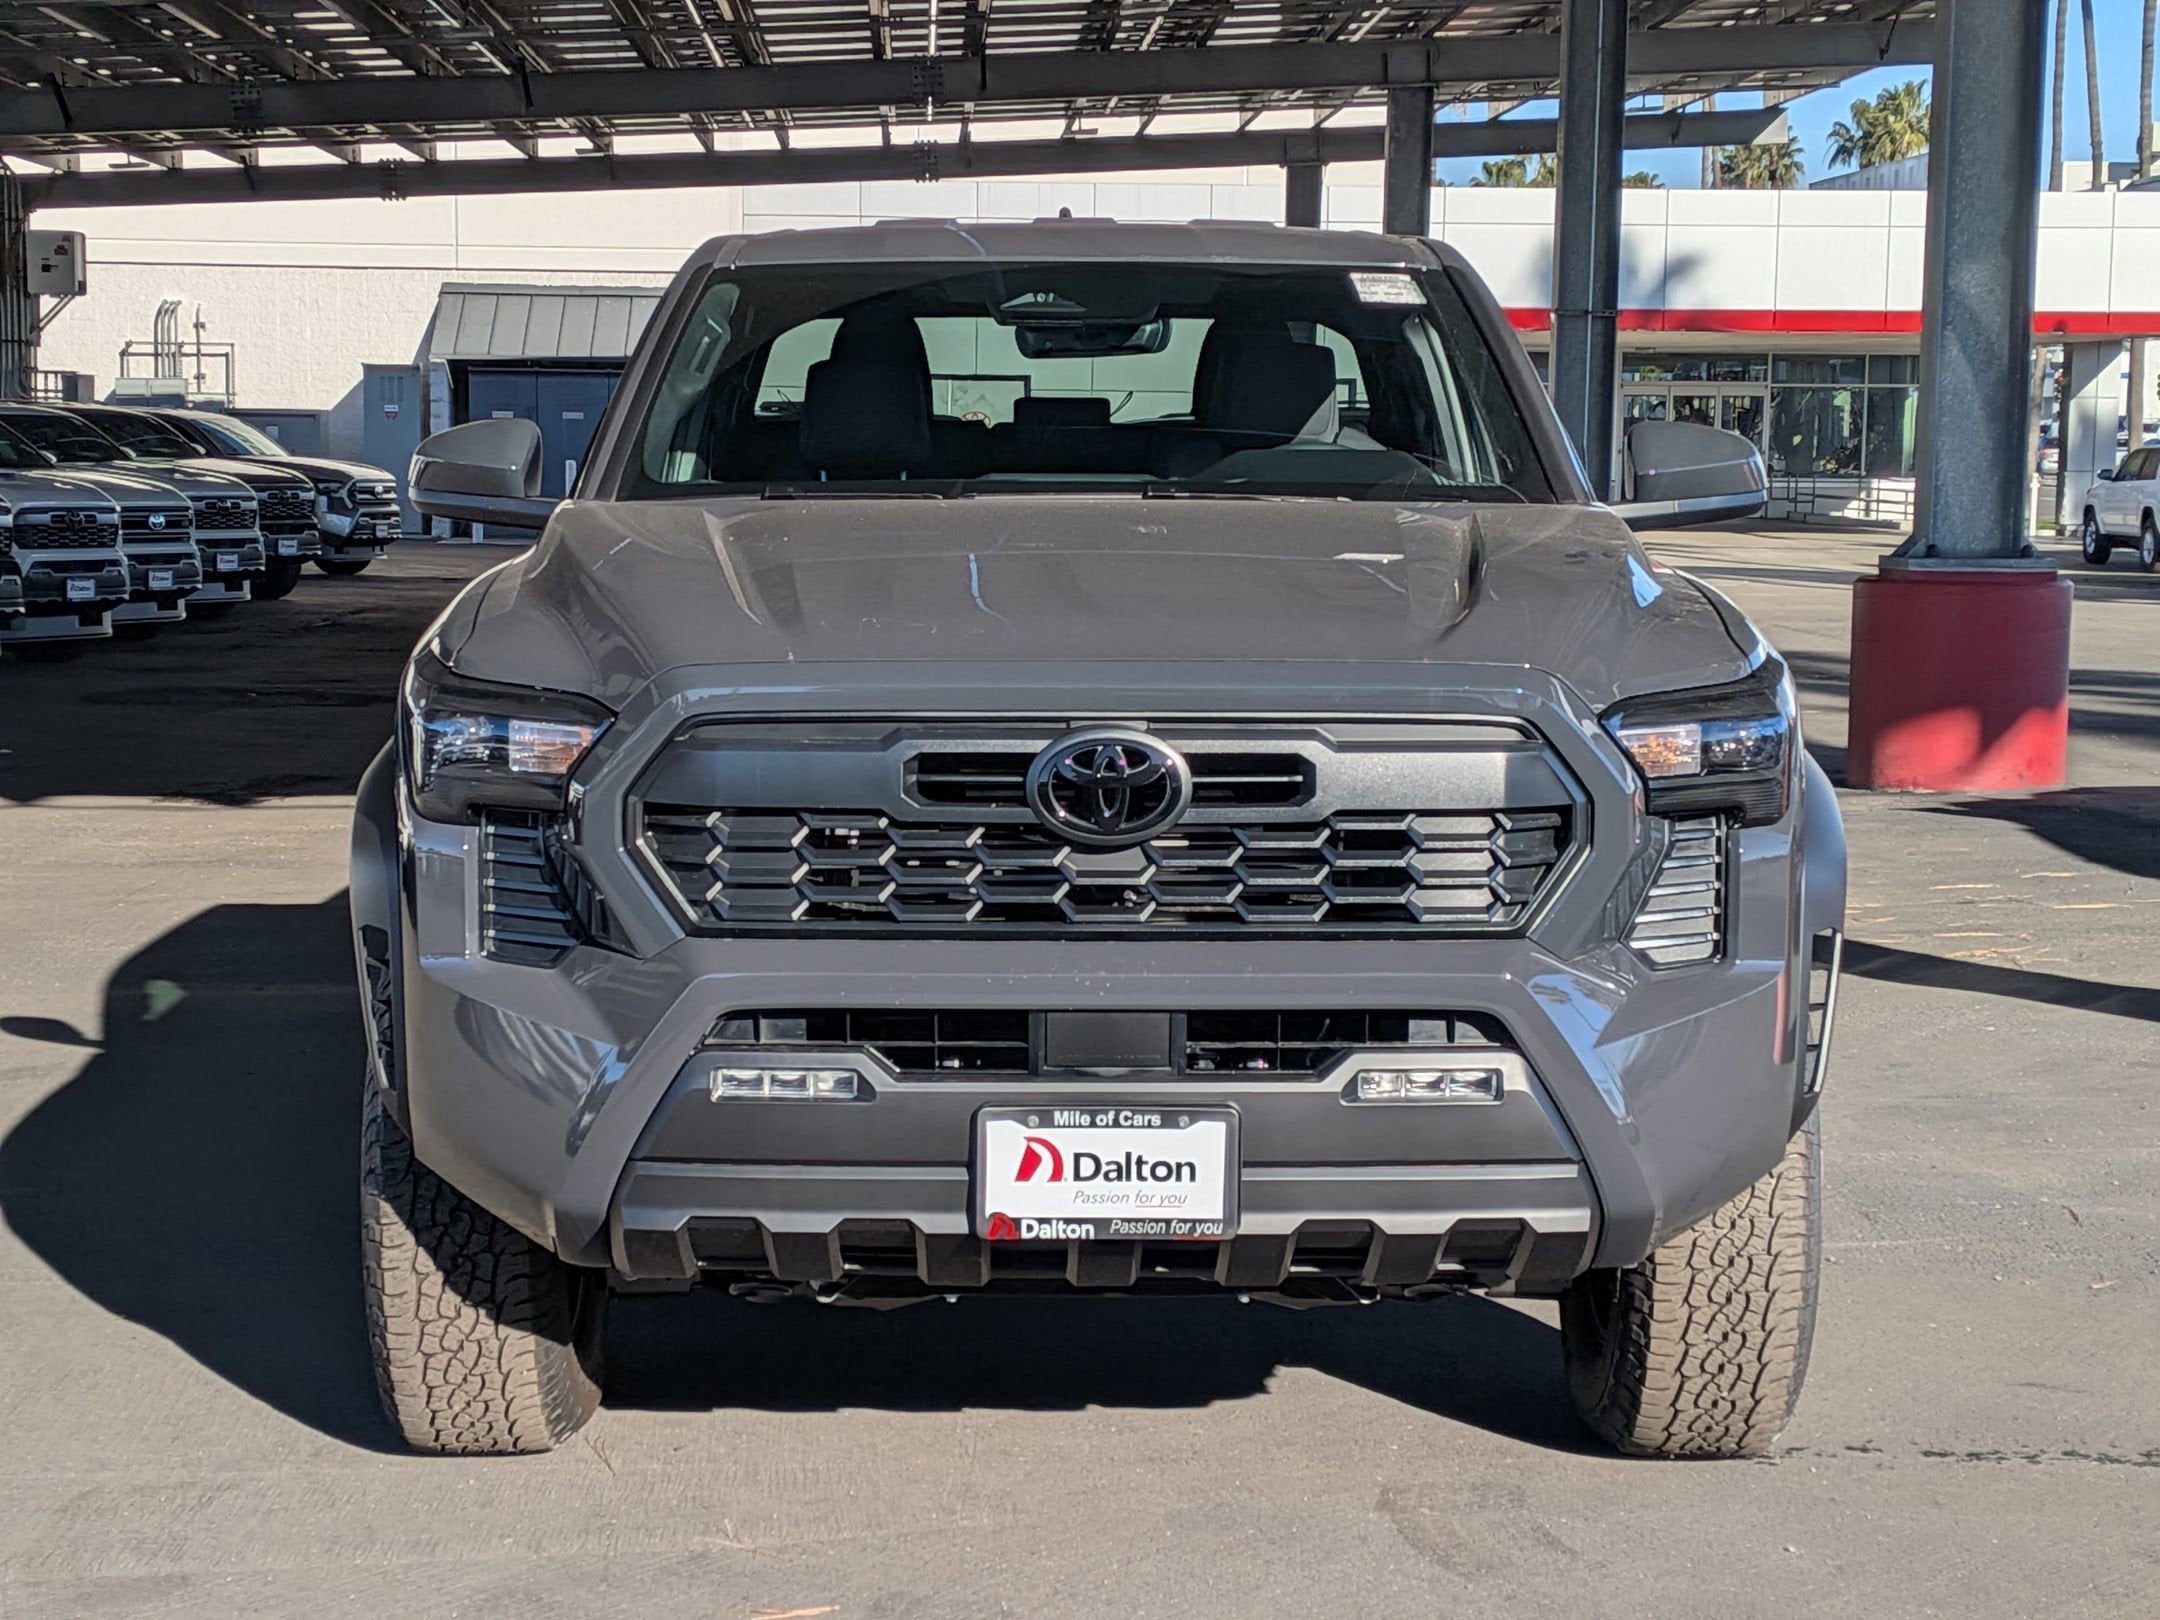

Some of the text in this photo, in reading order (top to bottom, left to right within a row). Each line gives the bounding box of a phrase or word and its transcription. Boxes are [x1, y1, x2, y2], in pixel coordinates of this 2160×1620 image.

[1053, 1110, 1162, 1127] Mile of Cars
[1073, 1151, 1196, 1183] Dalton
[1073, 1190, 1188, 1206] Passion for you
[1021, 1219, 1223, 1240] Dalton Passion for you
